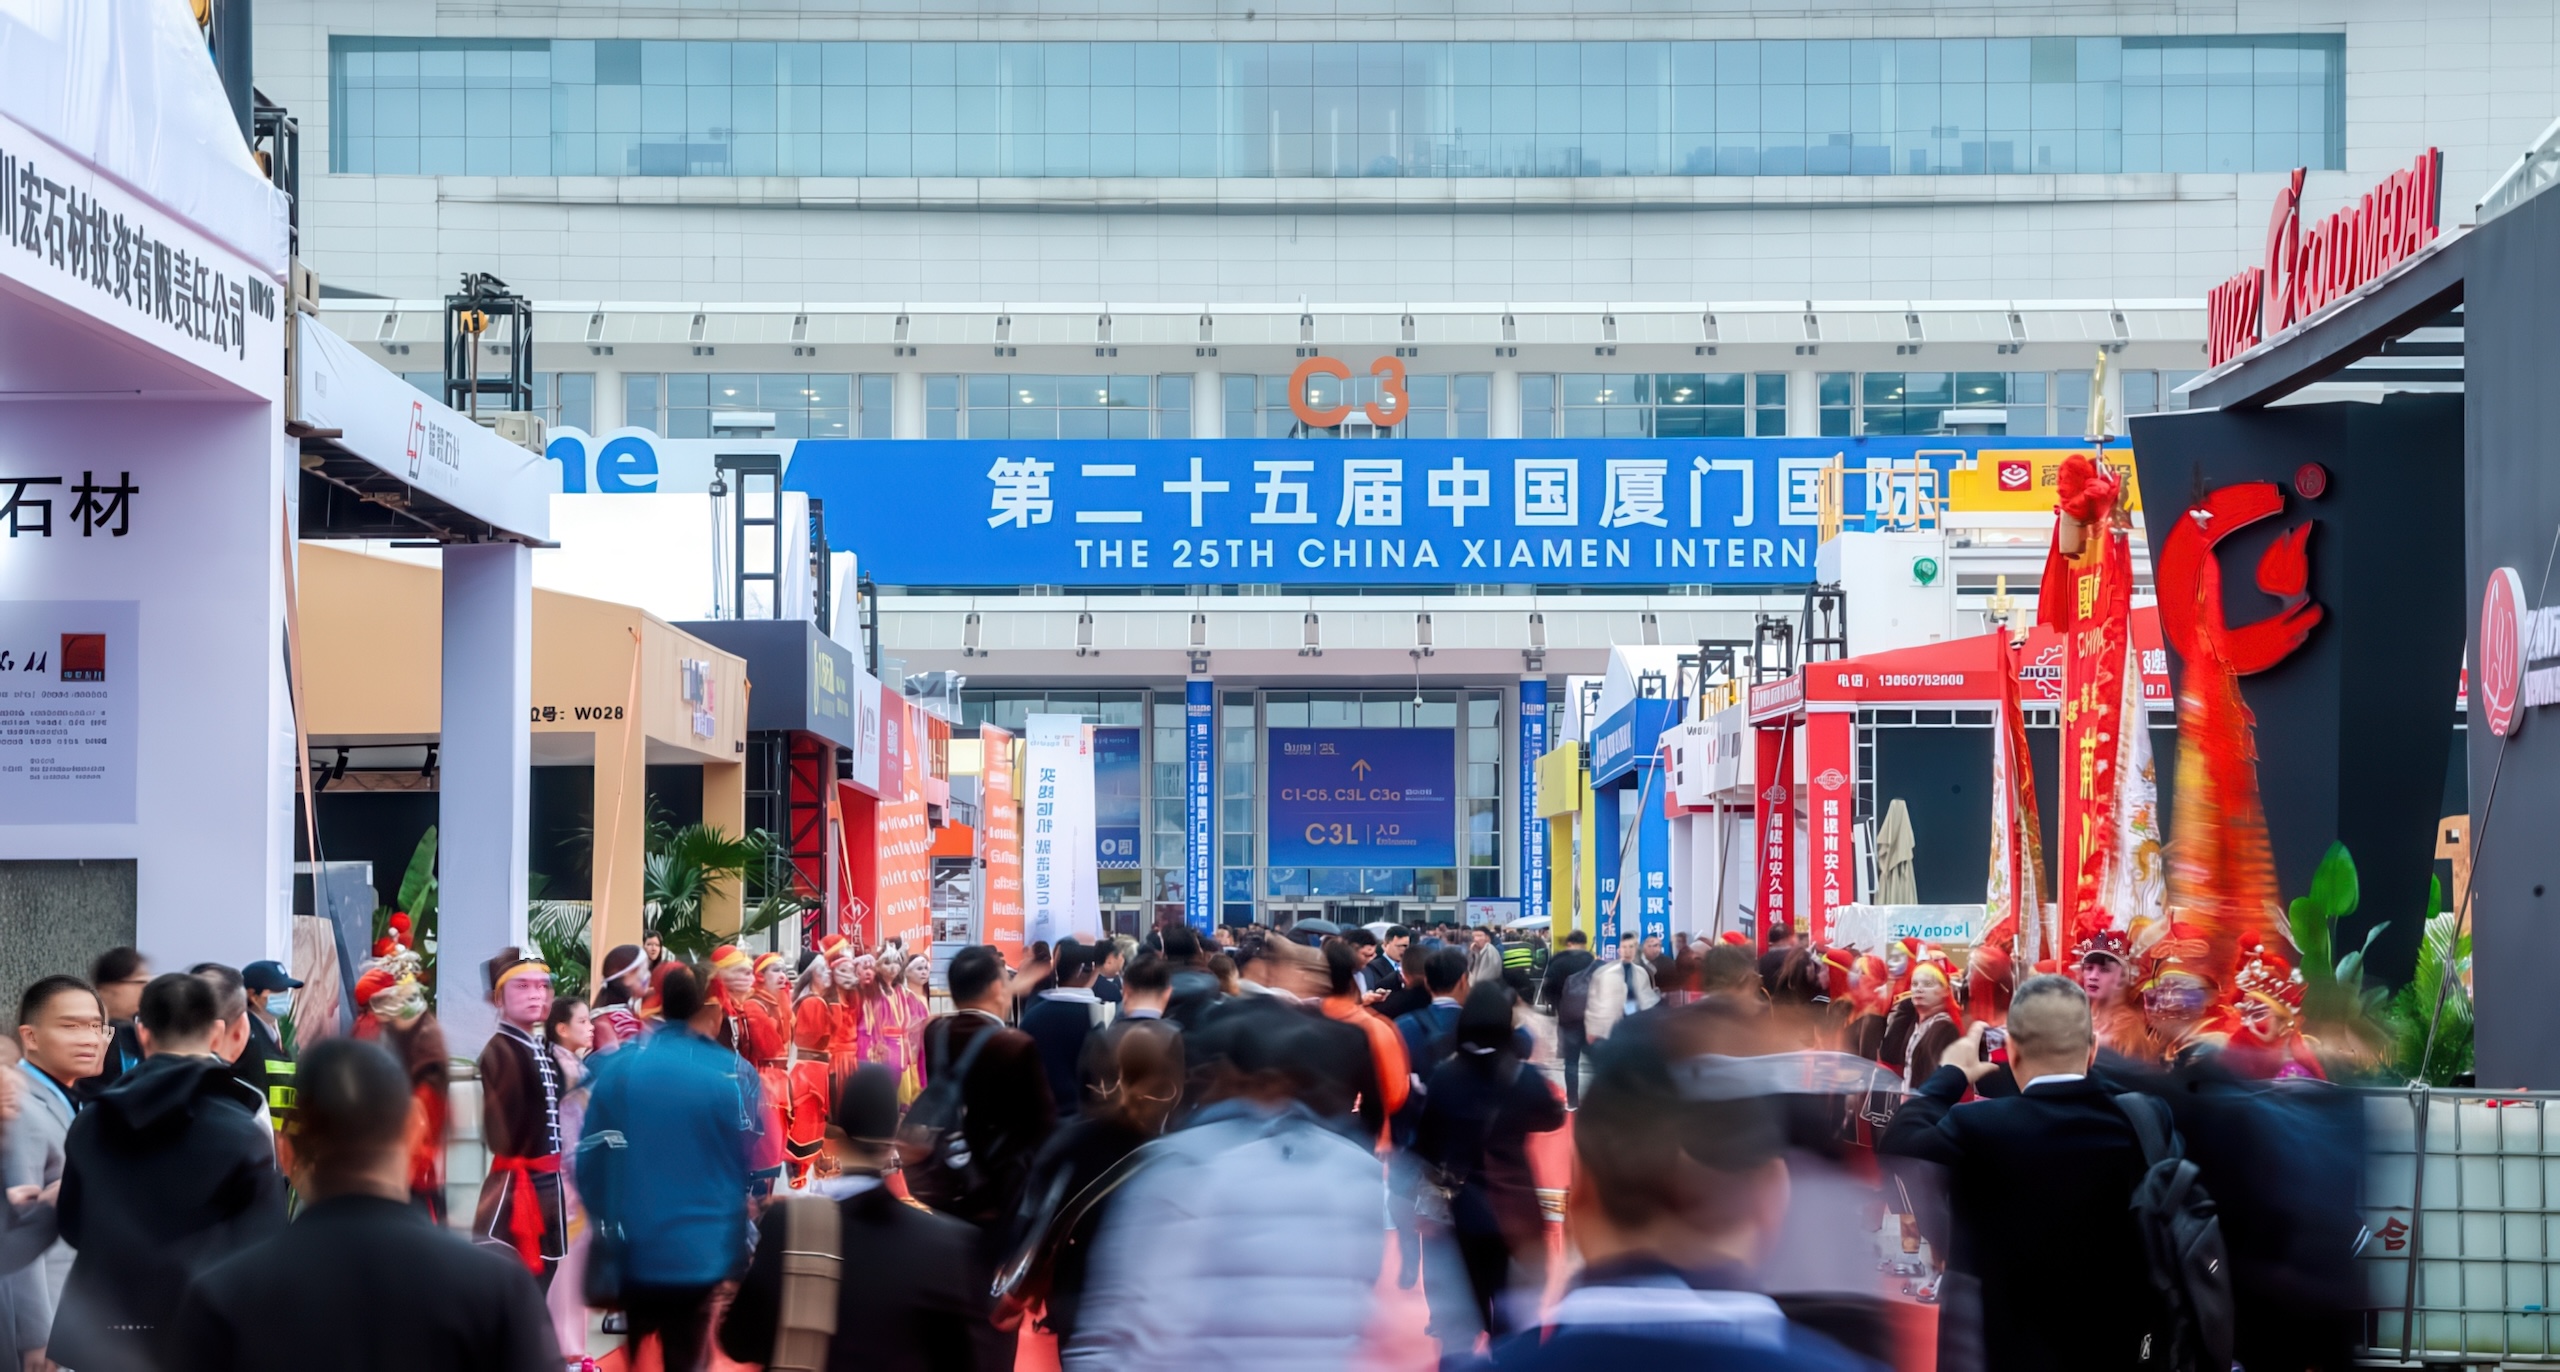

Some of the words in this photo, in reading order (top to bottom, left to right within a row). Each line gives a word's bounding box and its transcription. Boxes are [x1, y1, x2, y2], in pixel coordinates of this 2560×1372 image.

[2295, 206, 2354, 321] GOLD
[2354, 147, 2439, 286] MEDAL
[1288, 356, 1409, 428] C3
[0, 471, 139, 538] 石材
[1075, 539, 1148, 568] THE
[1173, 539, 1274, 568] 25TH
[1298, 539, 1440, 568] CHINA
[1461, 539, 1630, 568] XIAMEN
[574, 705, 624, 721] W028
[1305, 823, 1358, 845] C3L
